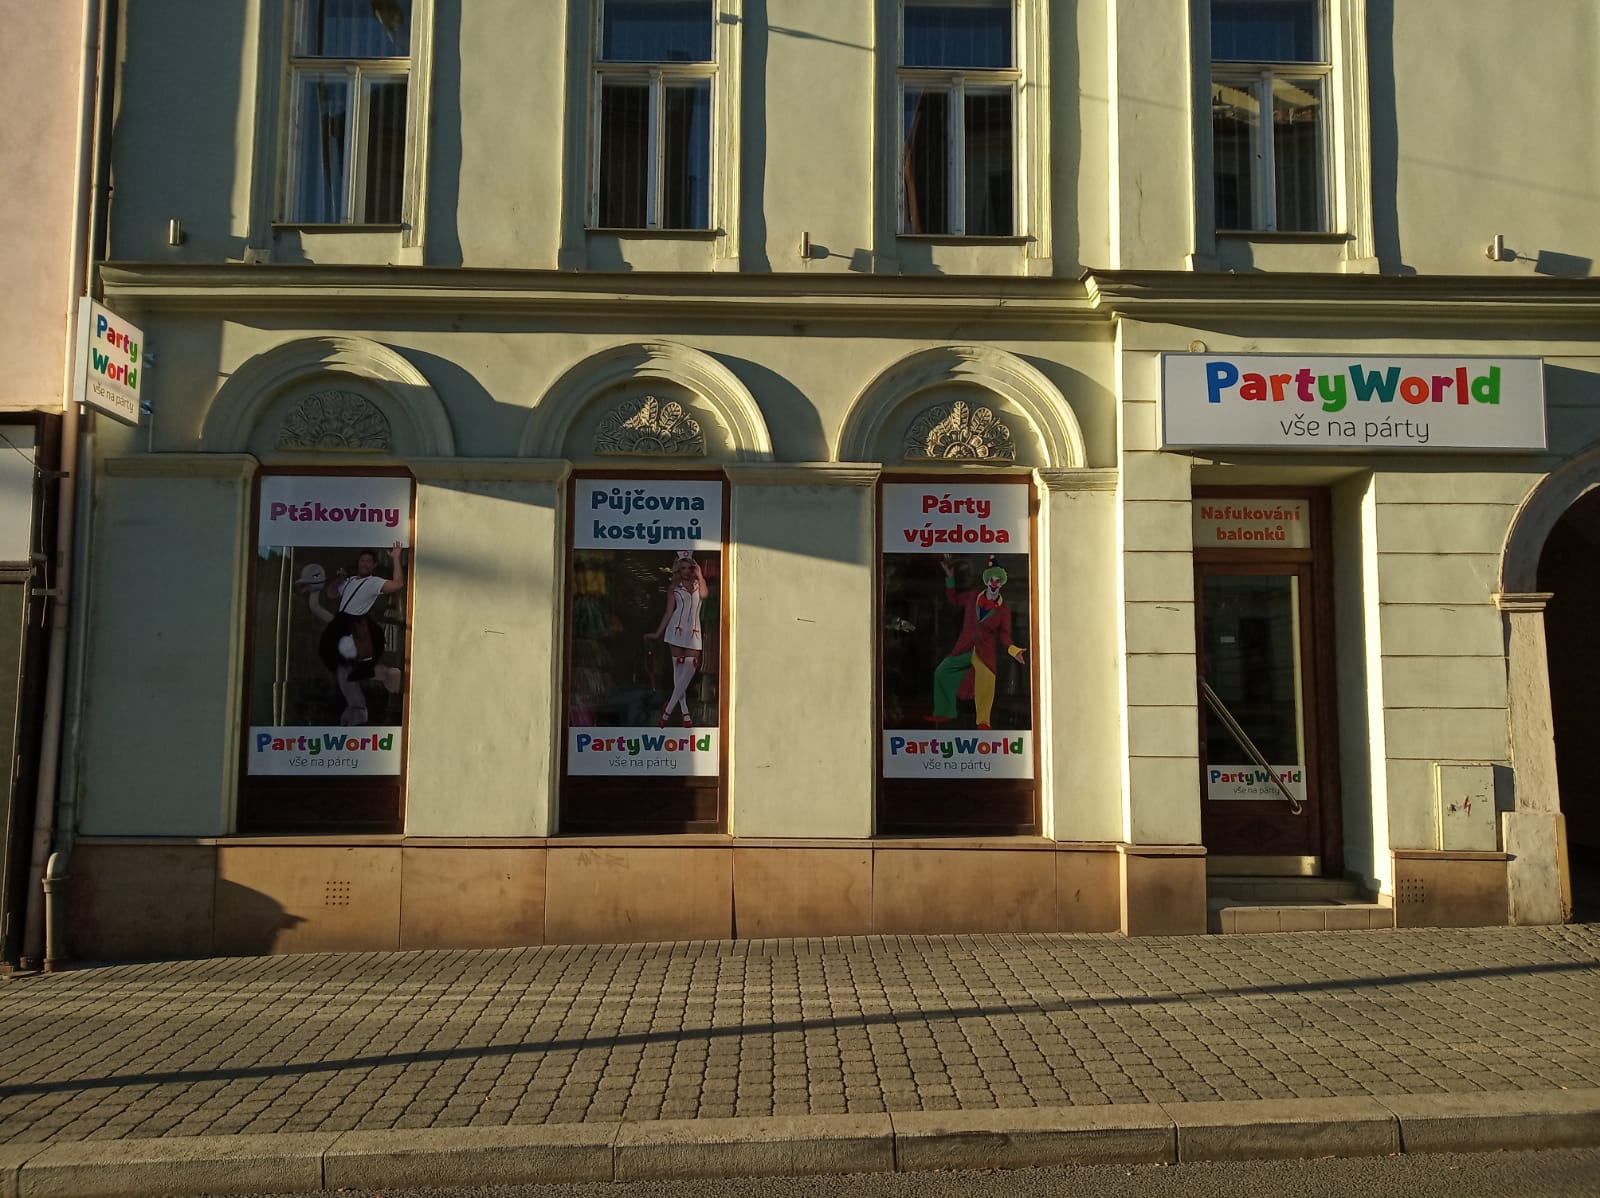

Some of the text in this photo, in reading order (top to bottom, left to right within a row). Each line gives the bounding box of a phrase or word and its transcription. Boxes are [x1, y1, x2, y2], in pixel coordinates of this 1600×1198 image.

[96, 313, 138, 363] Party
[92, 347, 137, 389] World
[93, 382, 134, 413] vše na párty
[1206, 361, 1501, 412] PartyWorld
[1280, 413, 1430, 444] vše na párty
[591, 487, 705, 515] Půjčovna
[922, 493, 991, 518] Párty
[1201, 505, 1301, 520] Nafukování
[270, 501, 400, 527] Ptákoviny
[593, 518, 701, 544] kostýmů
[903, 522, 1010, 547] výzdoba
[1216, 525, 1286, 540] balonků
[256, 733, 394, 756] PartyWorld
[576, 733, 711, 756] PartyWorld
[890, 736, 1024, 759] PartyWorld
[289, 756, 358, 769] vše na párty
[608, 756, 677, 769] vše na párty
[923, 758, 991, 772] vše na párty
